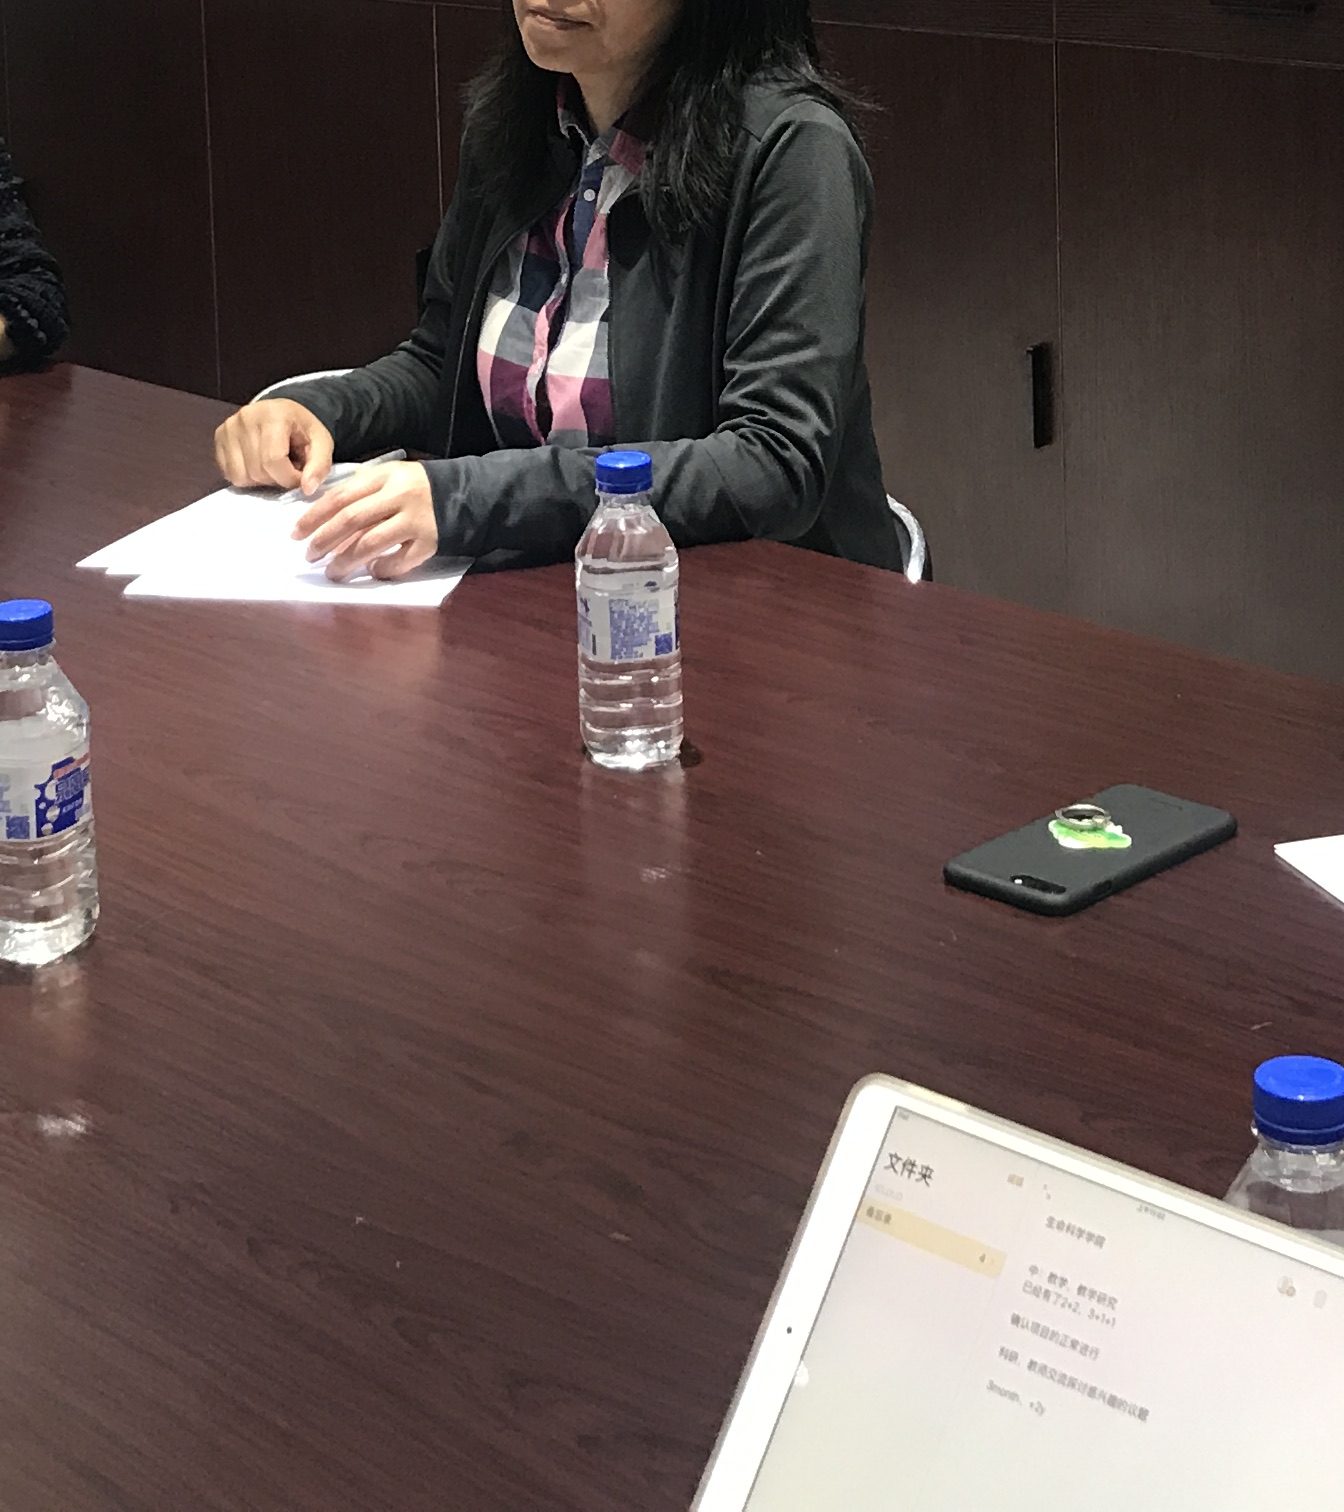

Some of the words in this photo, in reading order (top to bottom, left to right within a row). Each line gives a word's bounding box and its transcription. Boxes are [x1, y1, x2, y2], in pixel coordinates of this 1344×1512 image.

[883, 1151, 935, 1188] 文件夹
[1045, 1215, 1107, 1250] 生命科学学院
